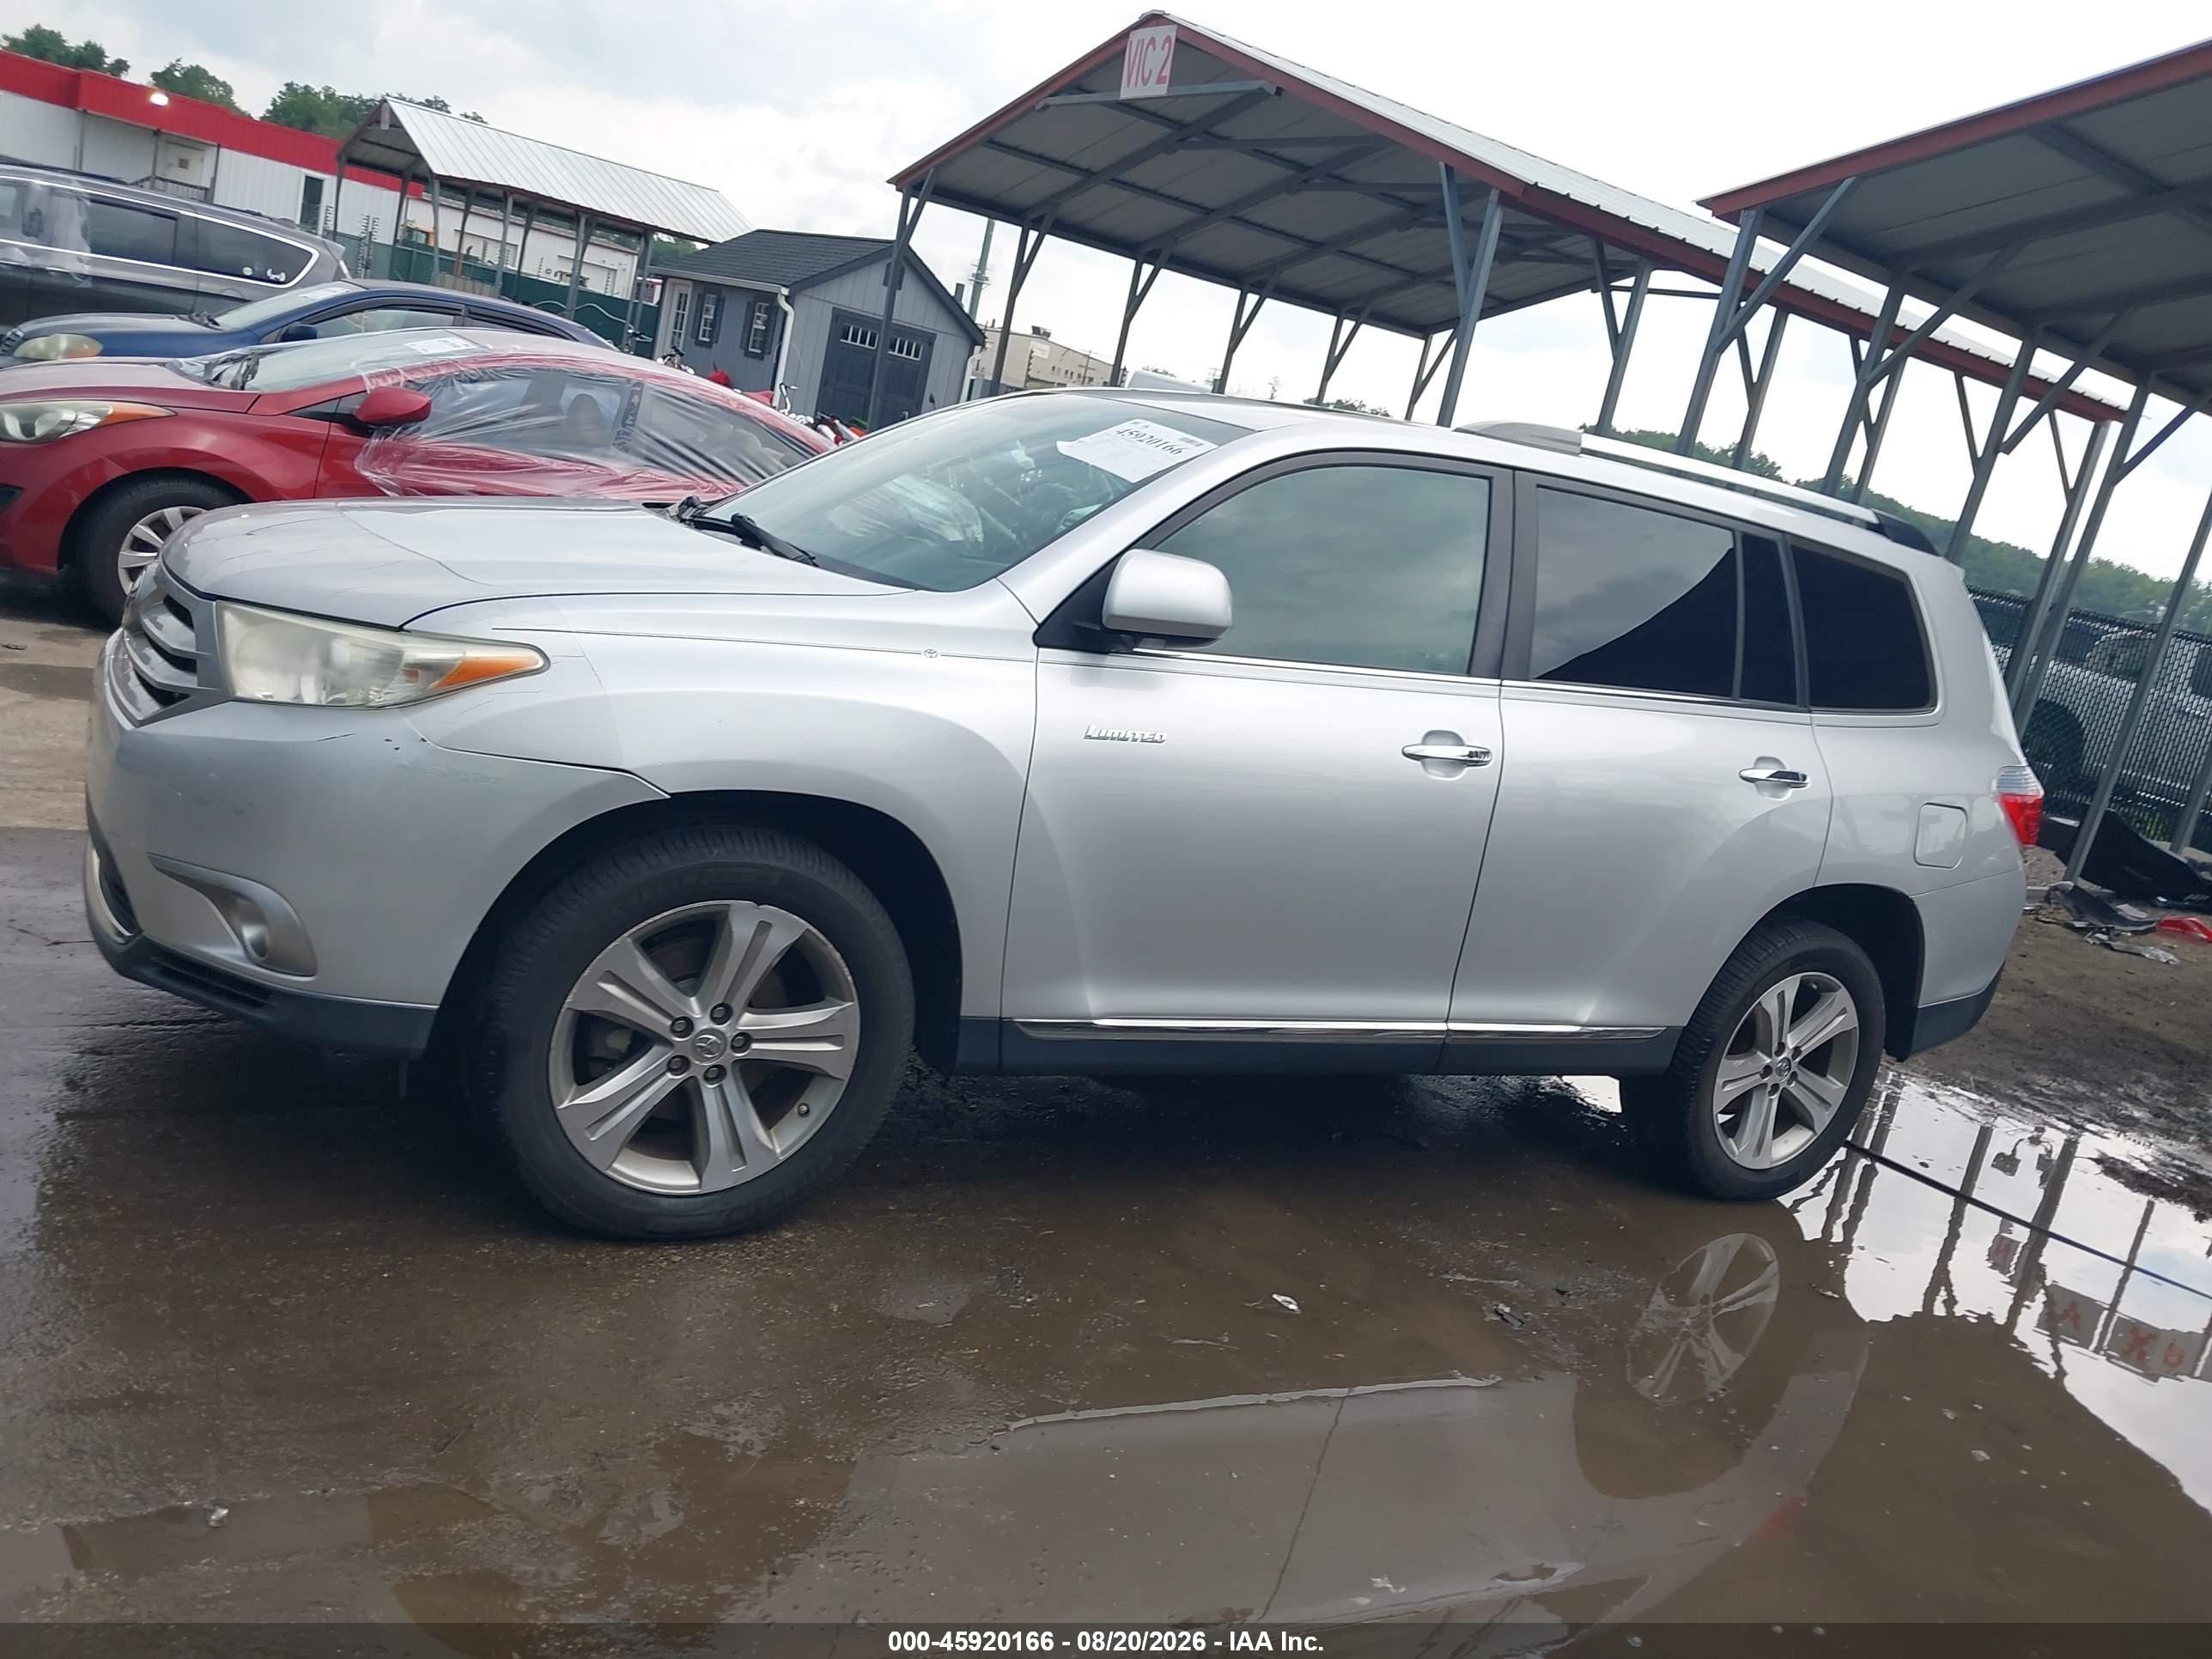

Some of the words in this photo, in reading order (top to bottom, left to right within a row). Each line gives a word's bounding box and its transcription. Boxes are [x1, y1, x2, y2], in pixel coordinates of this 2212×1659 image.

[1126, 36, 1156, 88] VIC
[1155, 35, 1172, 85] 2
[1116, 428, 1188, 455] 45920166
